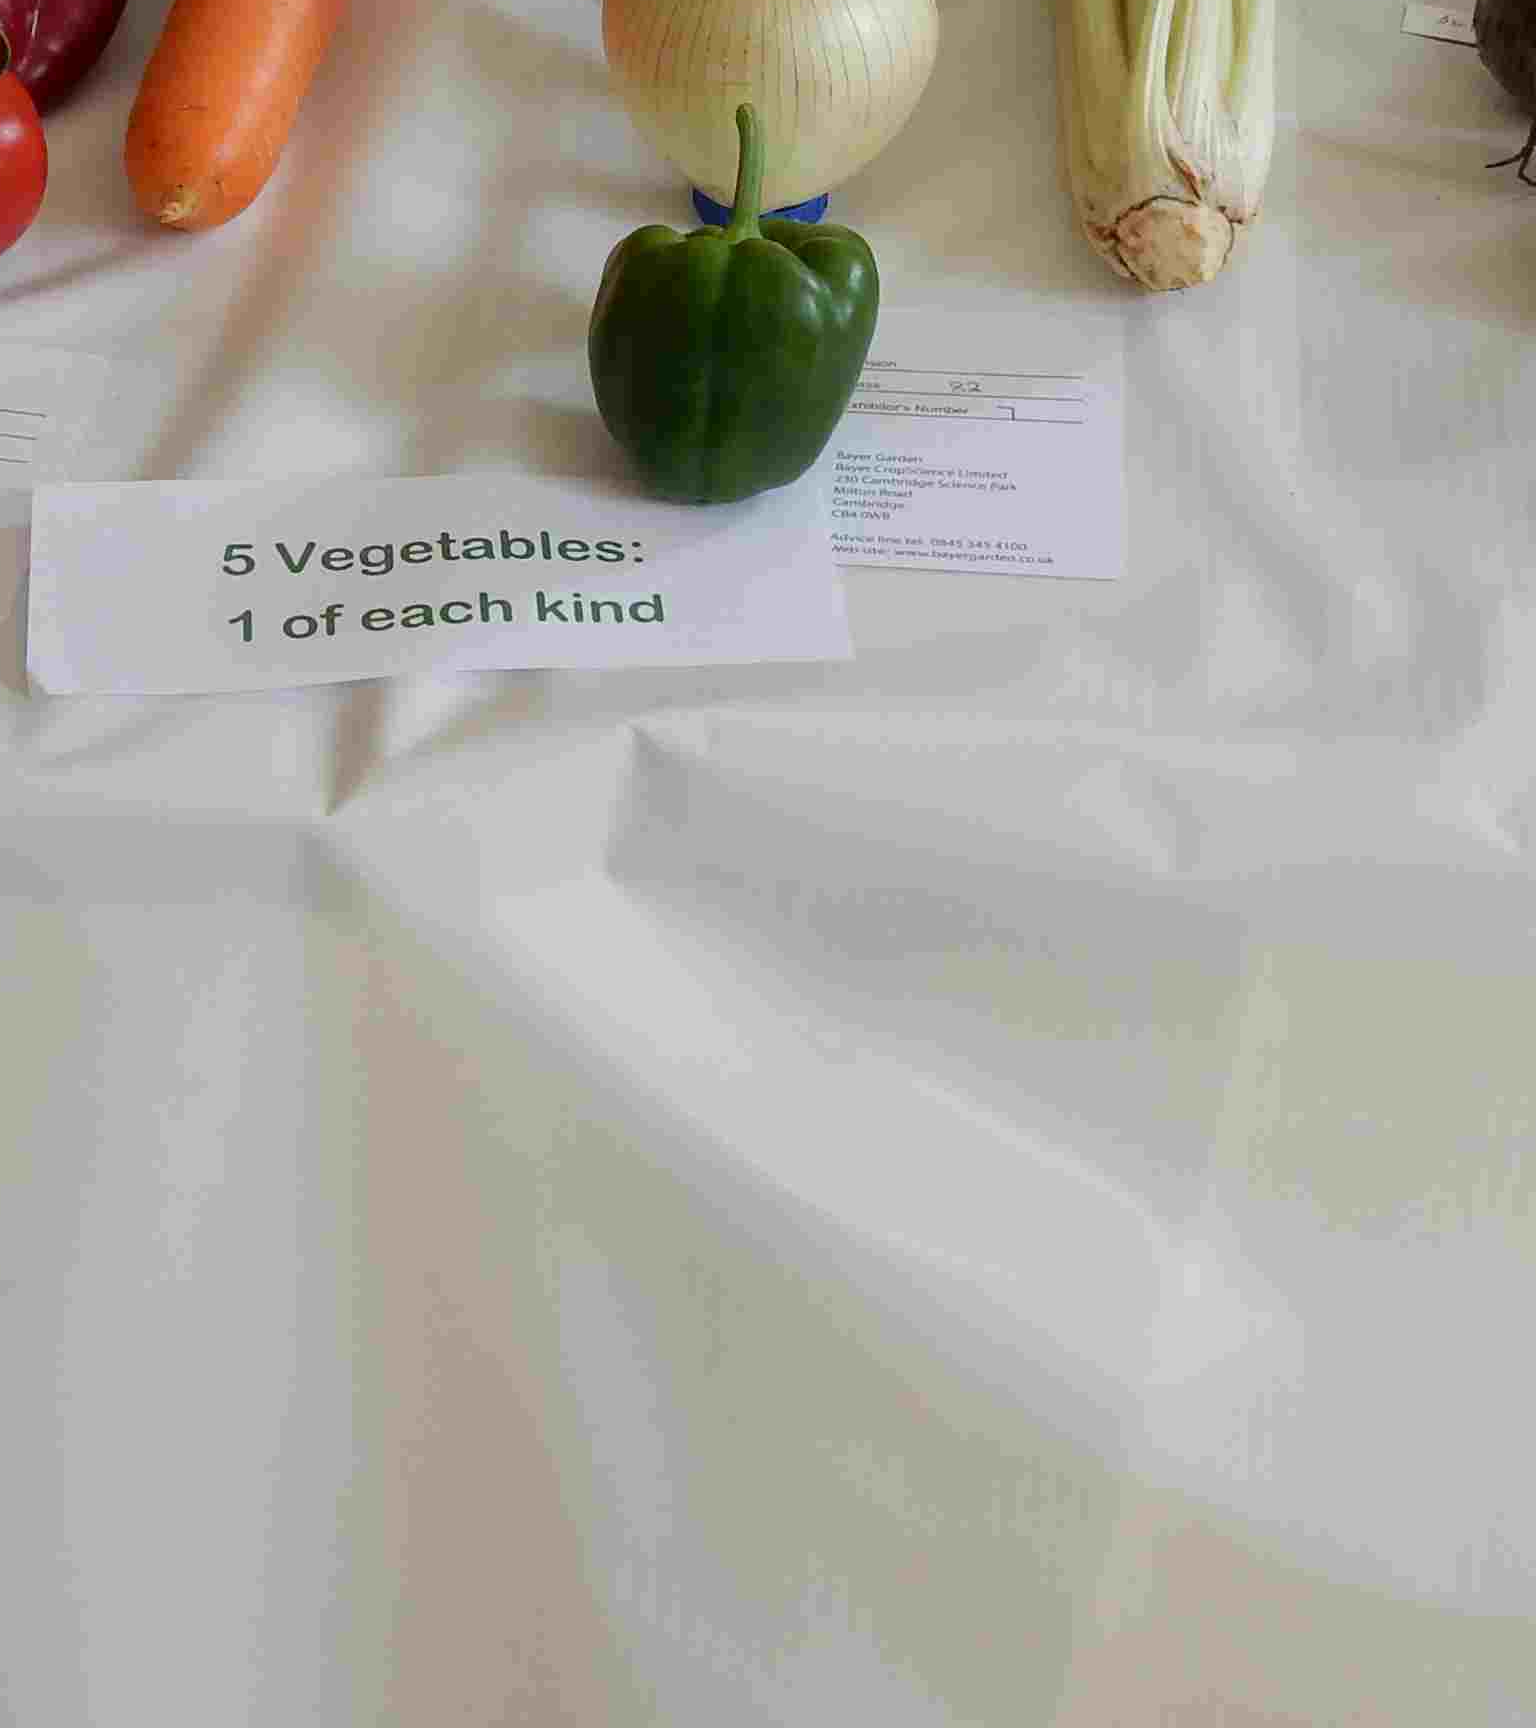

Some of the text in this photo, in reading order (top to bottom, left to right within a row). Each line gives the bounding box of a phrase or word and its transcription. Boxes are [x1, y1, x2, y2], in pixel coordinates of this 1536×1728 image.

[913, 404, 968, 415] Number
[832, 498, 905, 511] Cambridge
[223, 530, 644, 576] 5 Vegetables:
[228, 591, 665, 643] 1 of each kind
